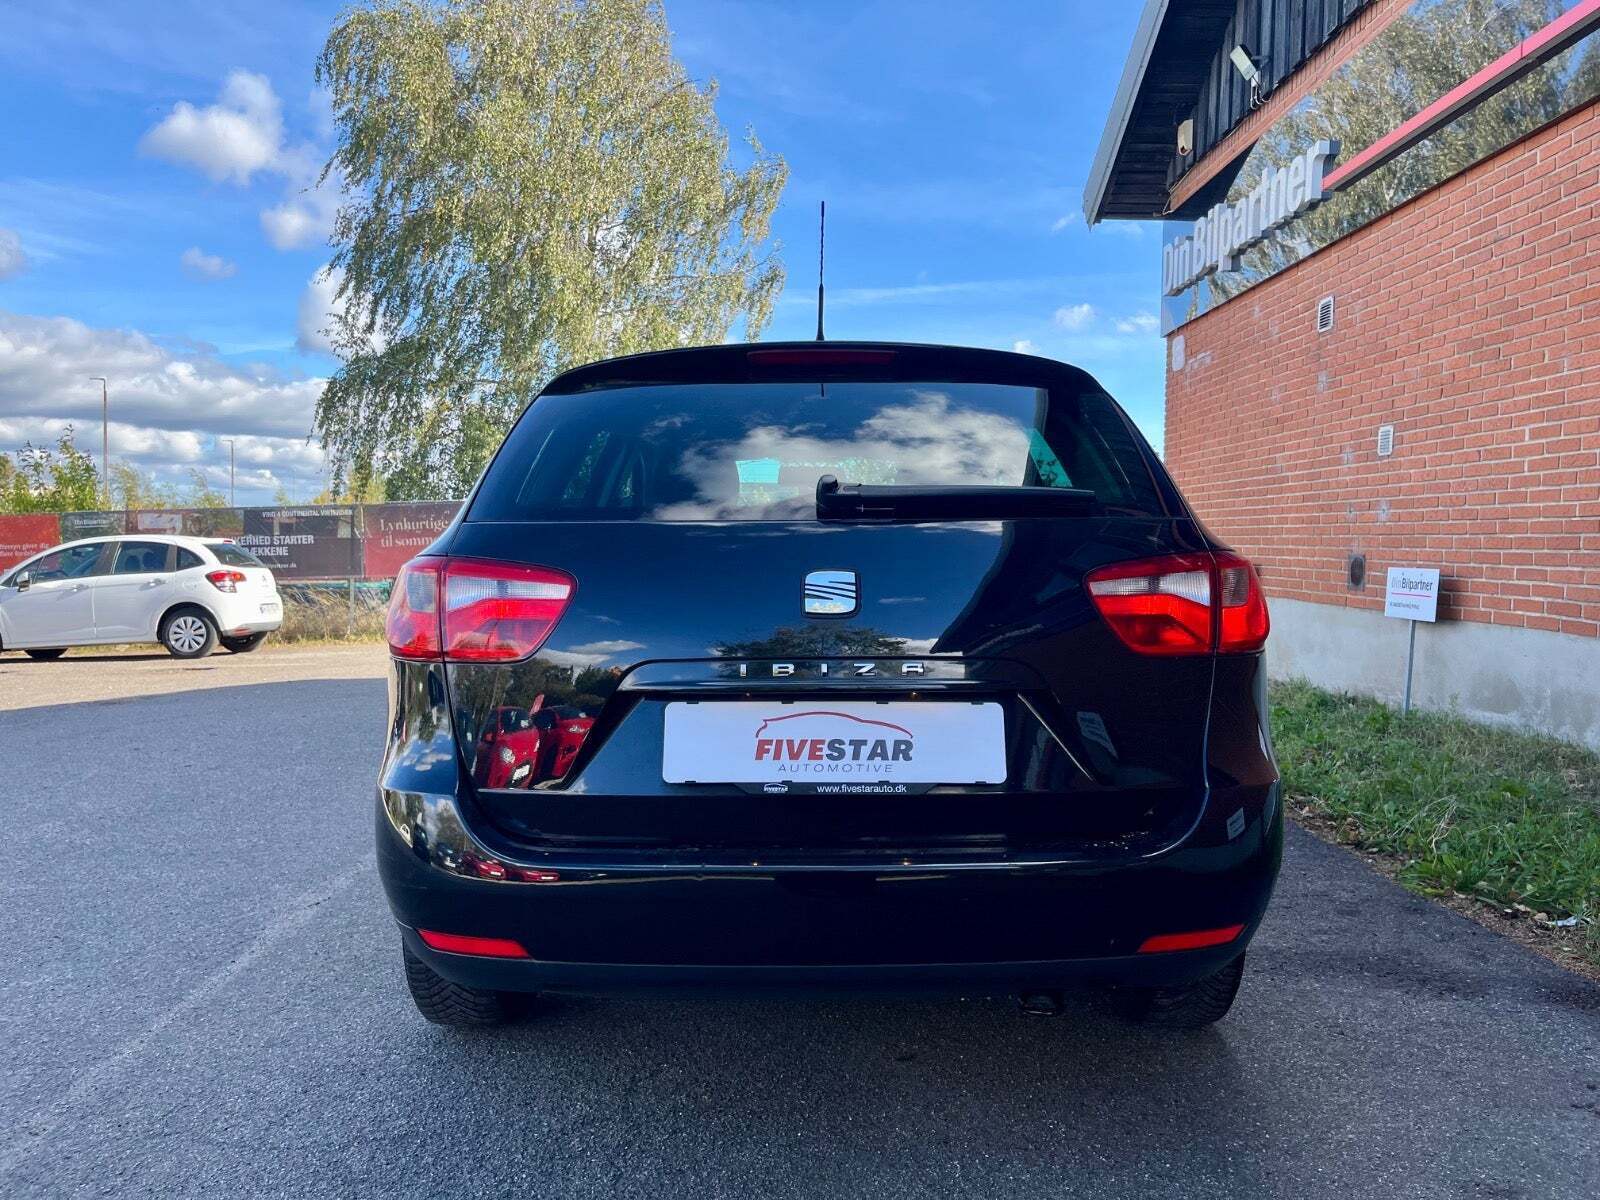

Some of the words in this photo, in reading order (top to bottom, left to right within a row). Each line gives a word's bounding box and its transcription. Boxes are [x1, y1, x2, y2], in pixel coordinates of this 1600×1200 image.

[380, 517, 449, 532] Lynhurtige
[273, 535, 314, 545] STARTER
[381, 534, 393, 548] til
[740, 662, 925, 677] IBIZA
[755, 738, 914, 761] FIVESTAR
[777, 763, 893, 773] AUTOMOTIVE
[817, 783, 907, 793] www.fivestarauto.dk
